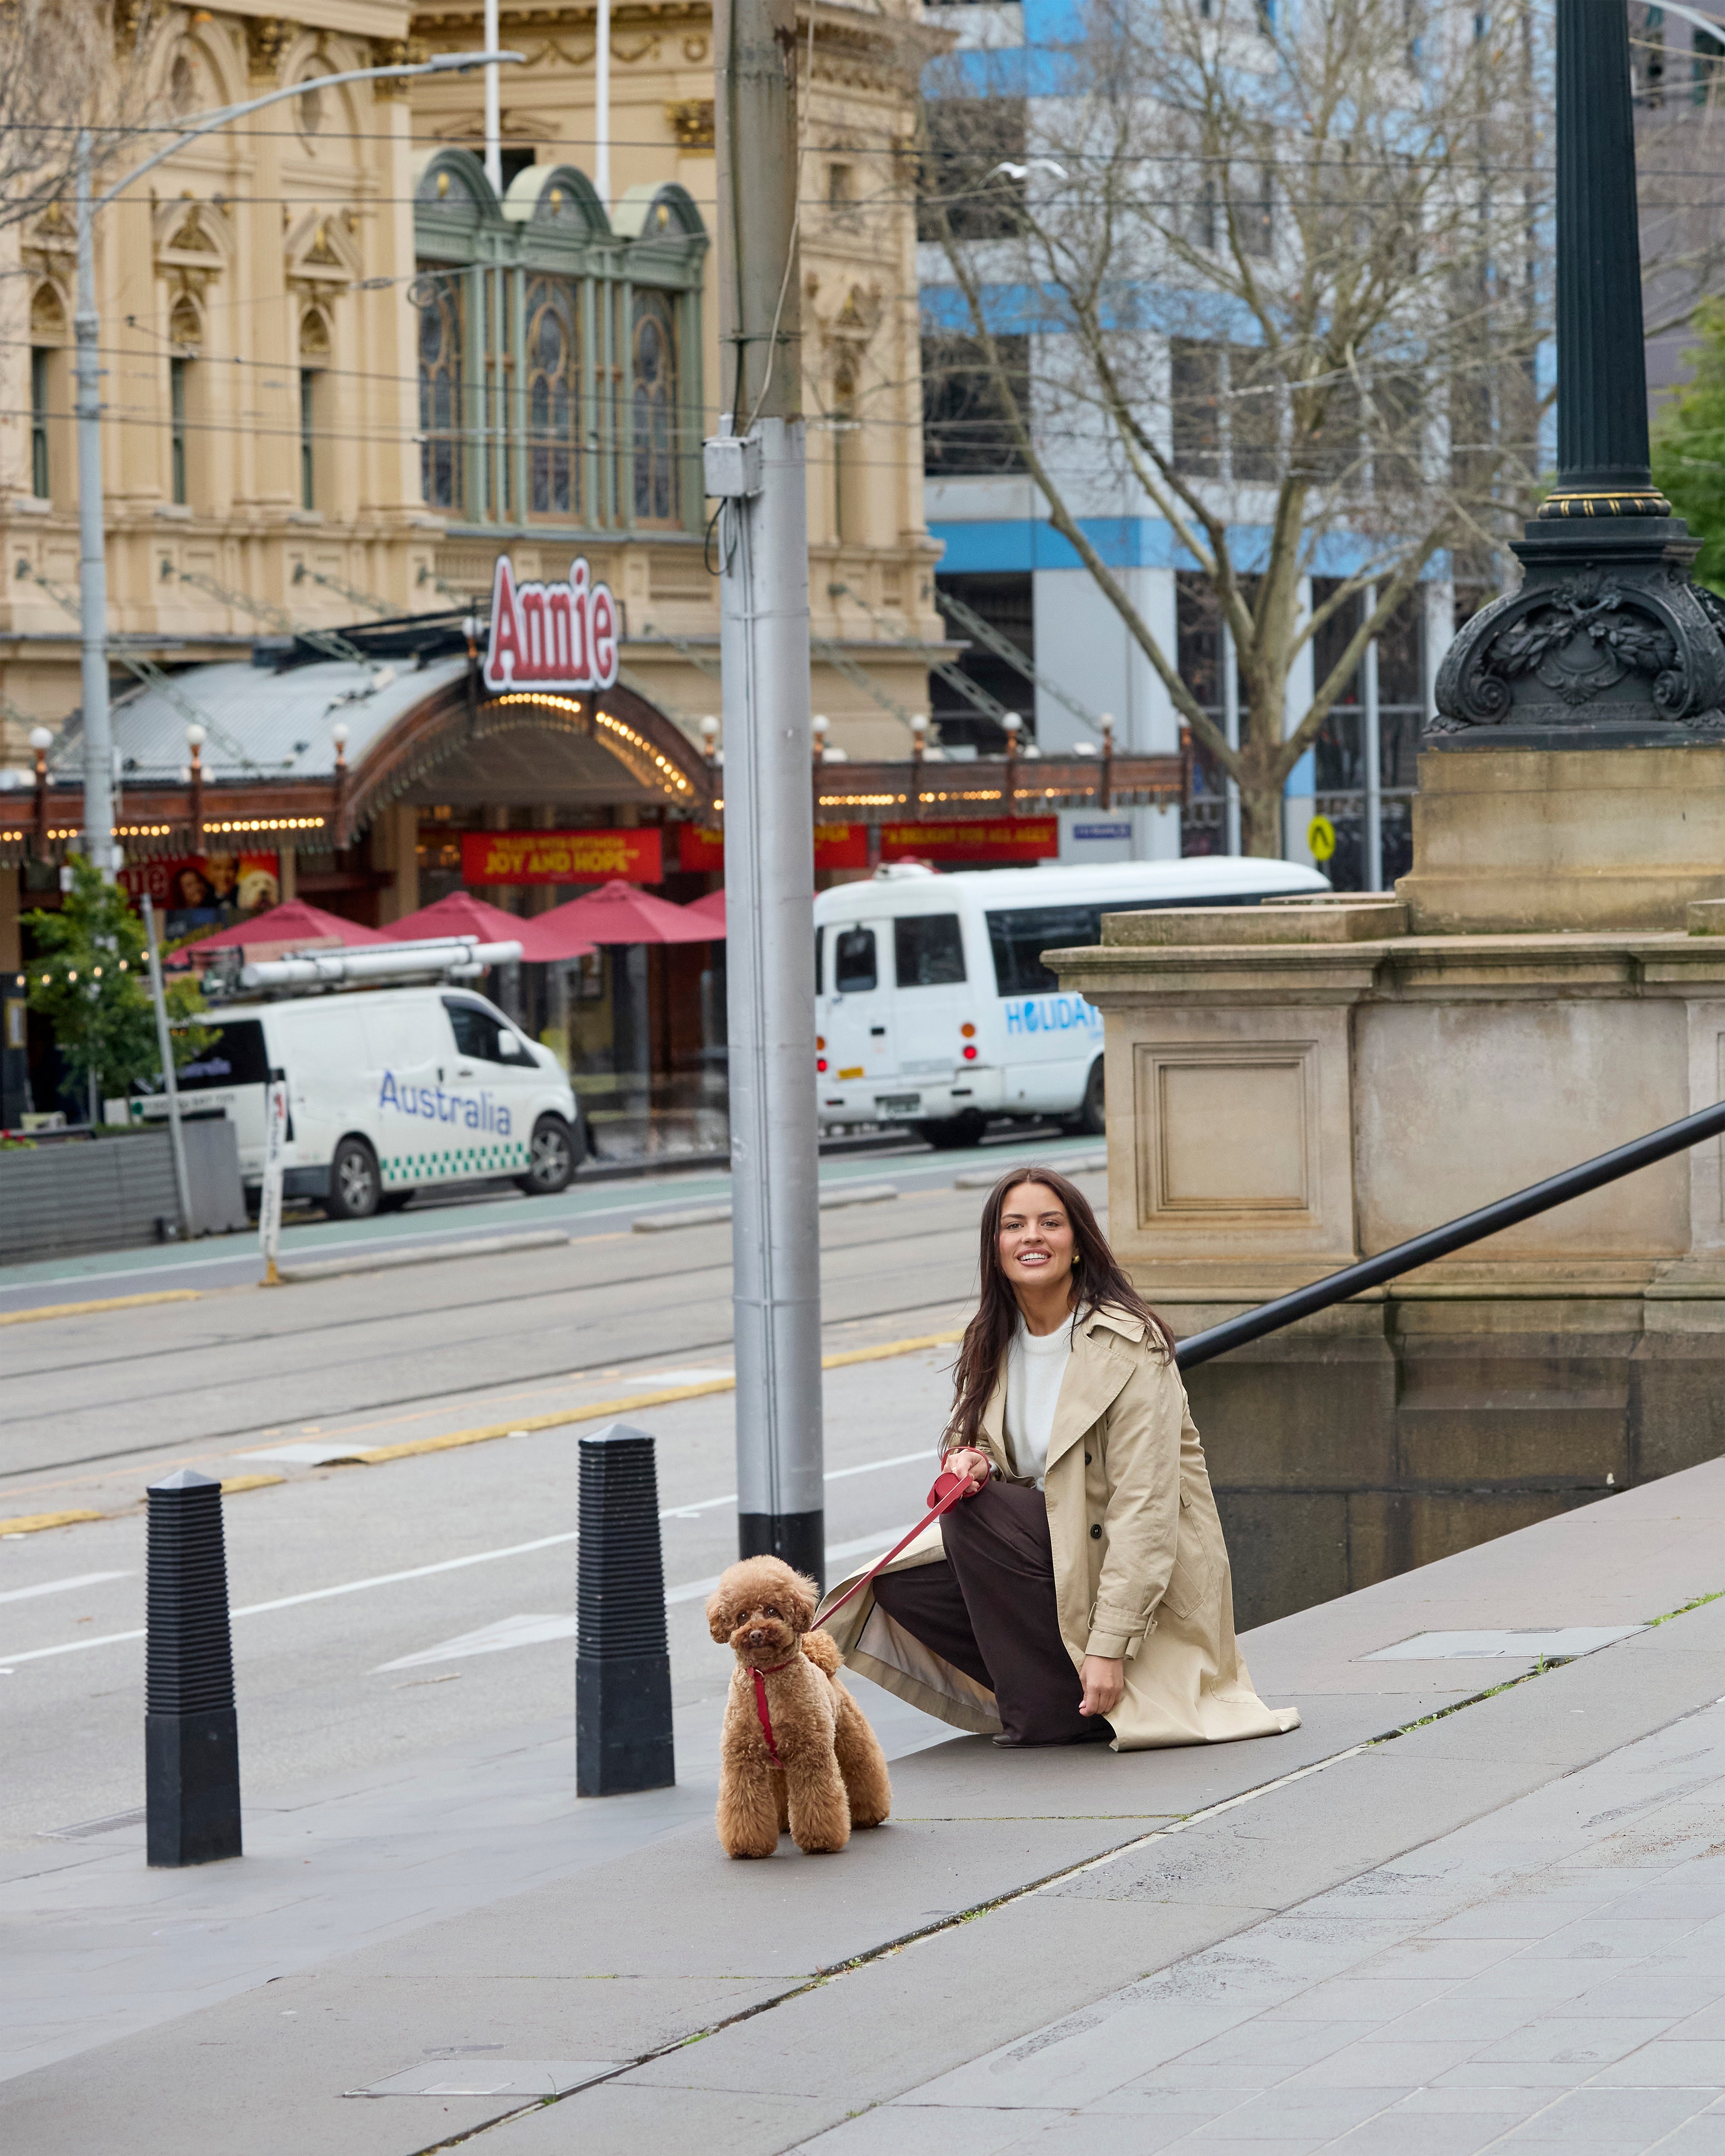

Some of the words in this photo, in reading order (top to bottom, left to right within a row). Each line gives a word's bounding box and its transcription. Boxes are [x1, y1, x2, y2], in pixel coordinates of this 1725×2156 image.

[485, 555, 618, 690] Annie
[485, 851, 524, 874] JOY
[528, 851, 571, 872] AND
[380, 1069, 511, 1135] Australia
